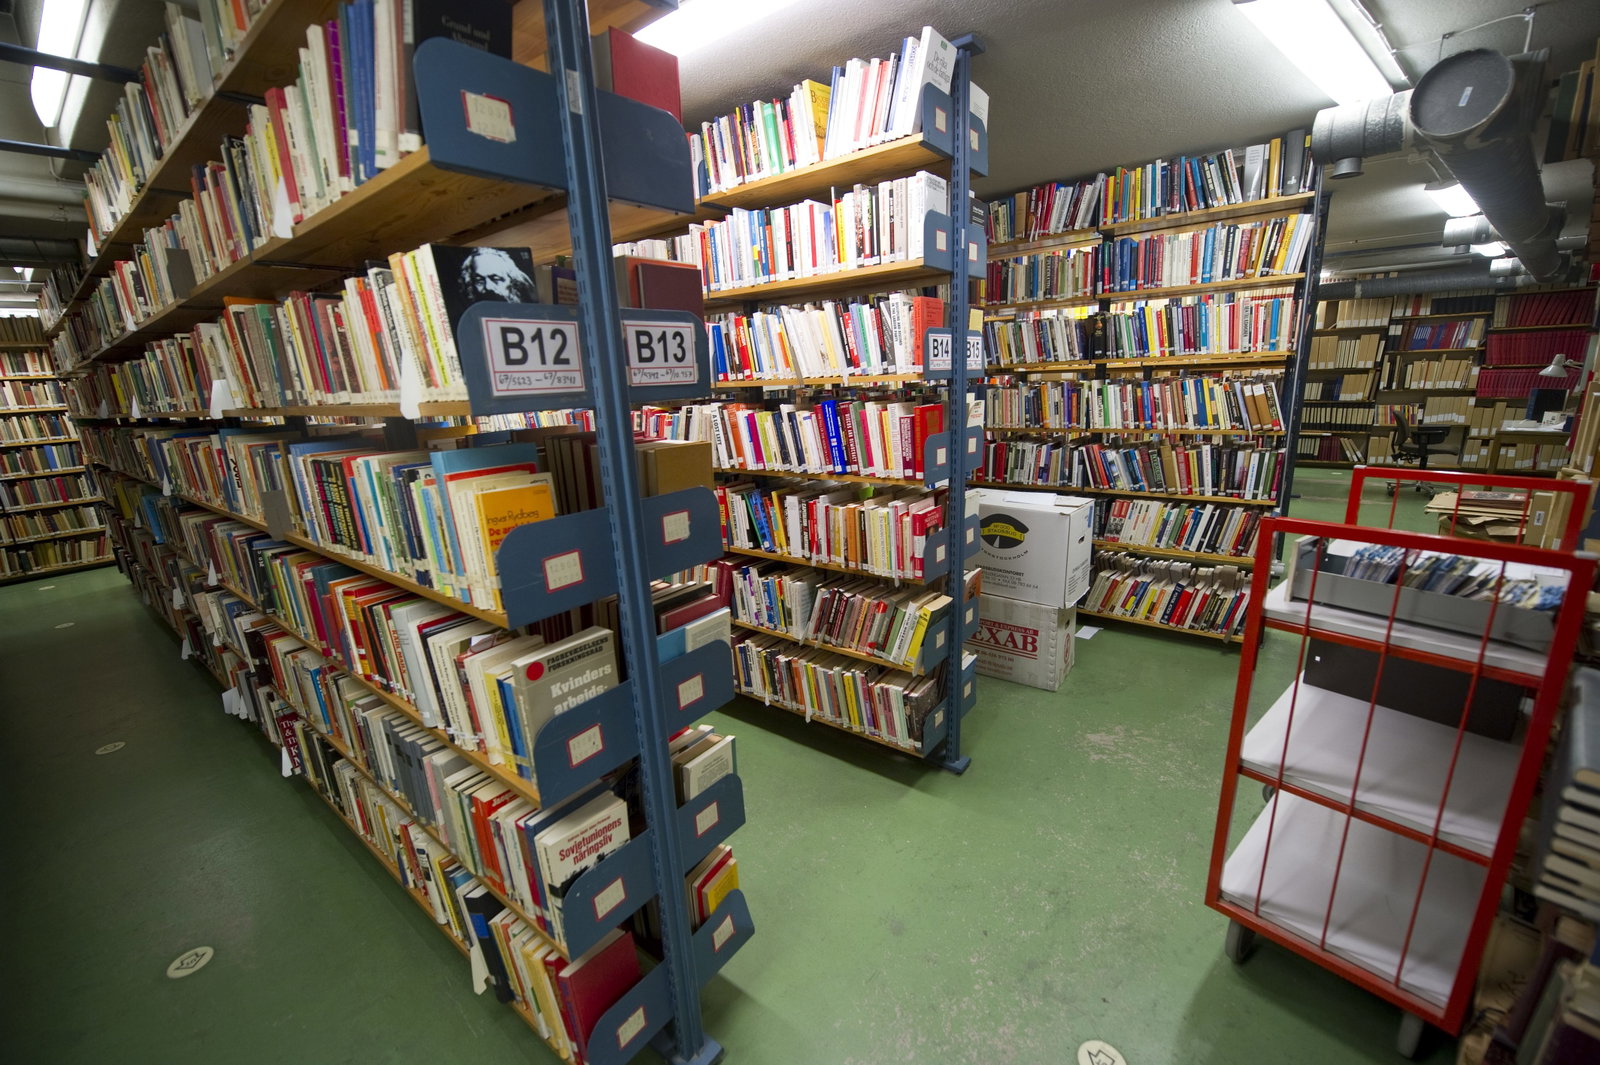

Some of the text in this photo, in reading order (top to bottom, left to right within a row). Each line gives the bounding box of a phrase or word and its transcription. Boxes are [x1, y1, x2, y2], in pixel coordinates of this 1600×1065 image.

[500, 326, 570, 366] B12
[634, 330, 686, 364] B13
[932, 338, 950, 358] B14
[967, 342, 980, 359] B15
[550, 664, 612, 698] Kvinders
[559, 817, 622, 862] Sovjetunionens
[573, 834, 613, 865] näringsliv
